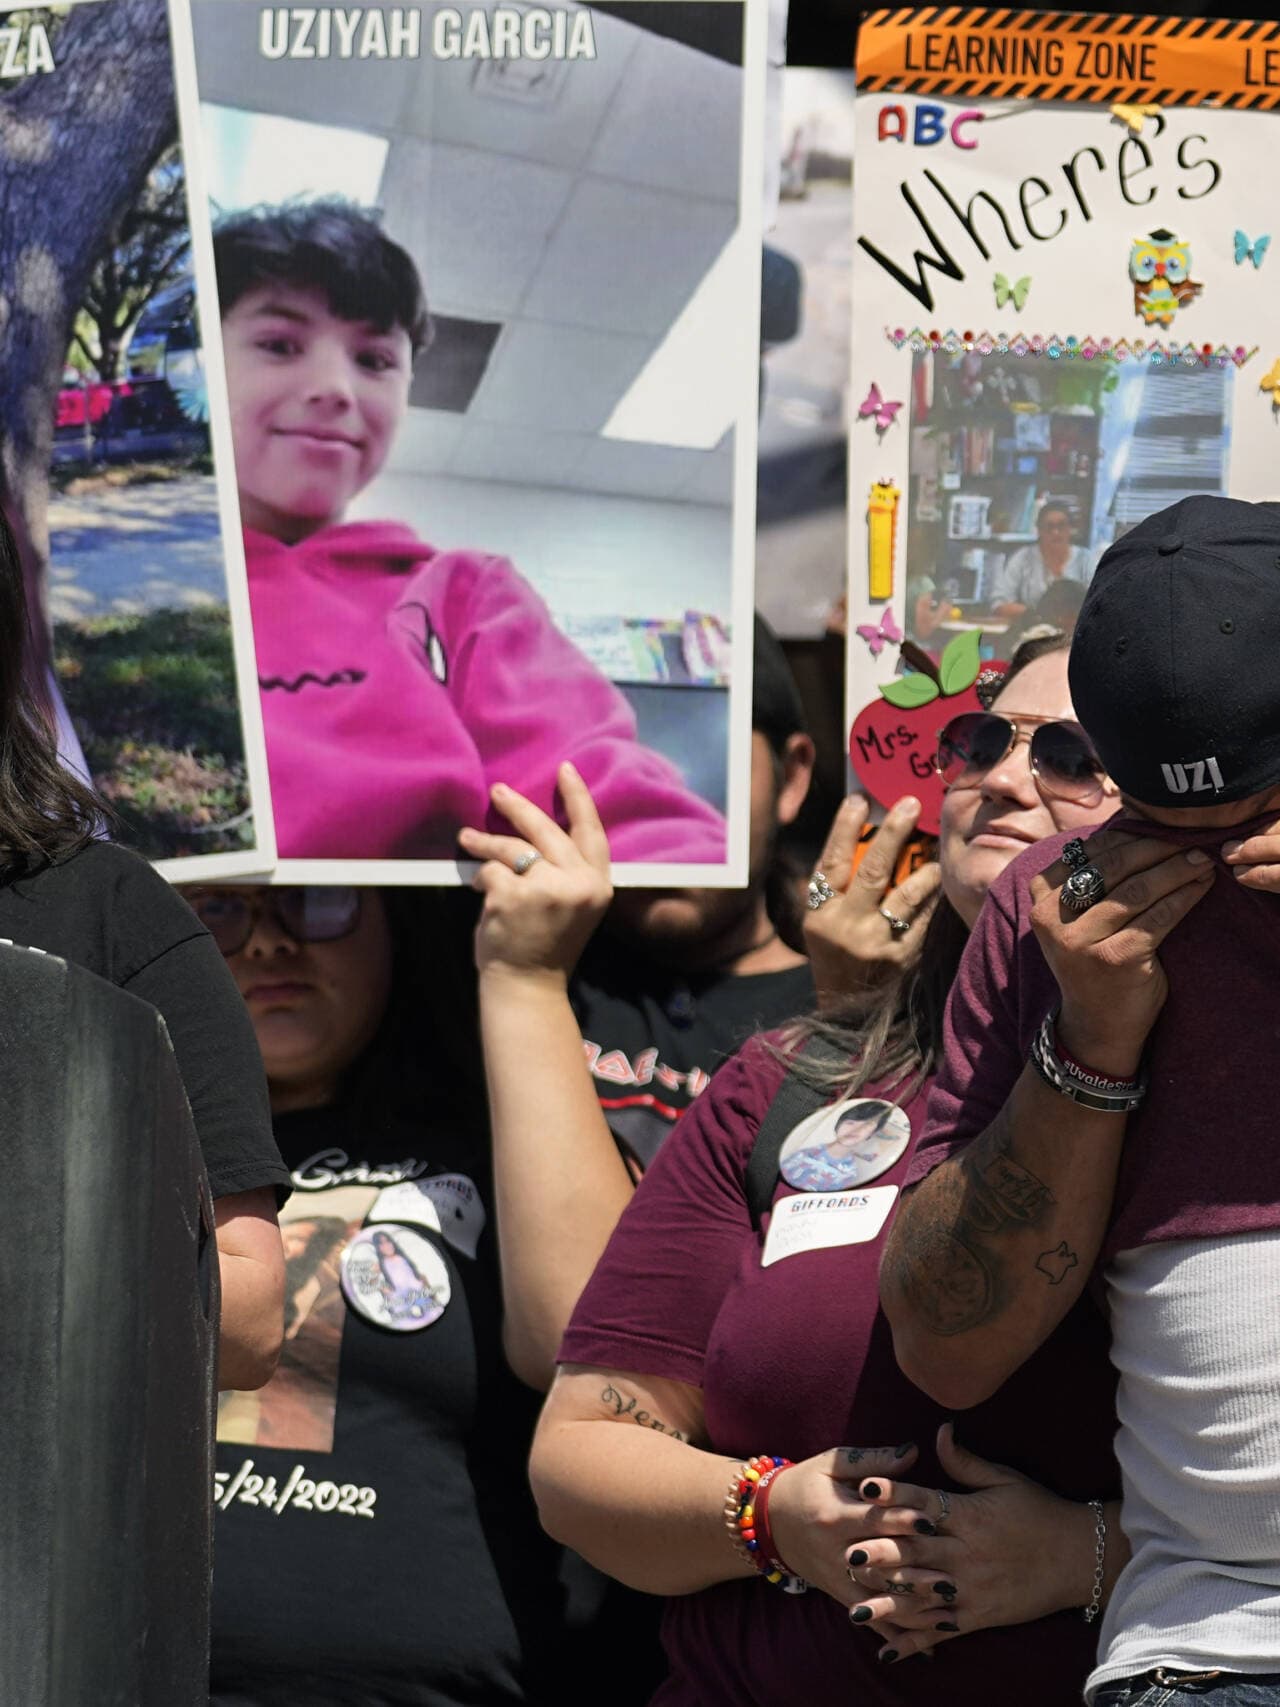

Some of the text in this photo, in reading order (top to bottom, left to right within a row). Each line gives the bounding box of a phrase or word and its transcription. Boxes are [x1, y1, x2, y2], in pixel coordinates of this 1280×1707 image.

[260, 9, 598, 60] UZIYAH GARCIA
[905, 34, 1157, 82] LEARNING ZONE
[878, 104, 986, 150] ABC
[857, 113, 1222, 313] Where's
[855, 725, 918, 763] Mrs.
[1160, 756, 1225, 794] UZI
[790, 1194, 871, 1213] GIFFORDS
[214, 1459, 377, 1519] 5/24/2022
